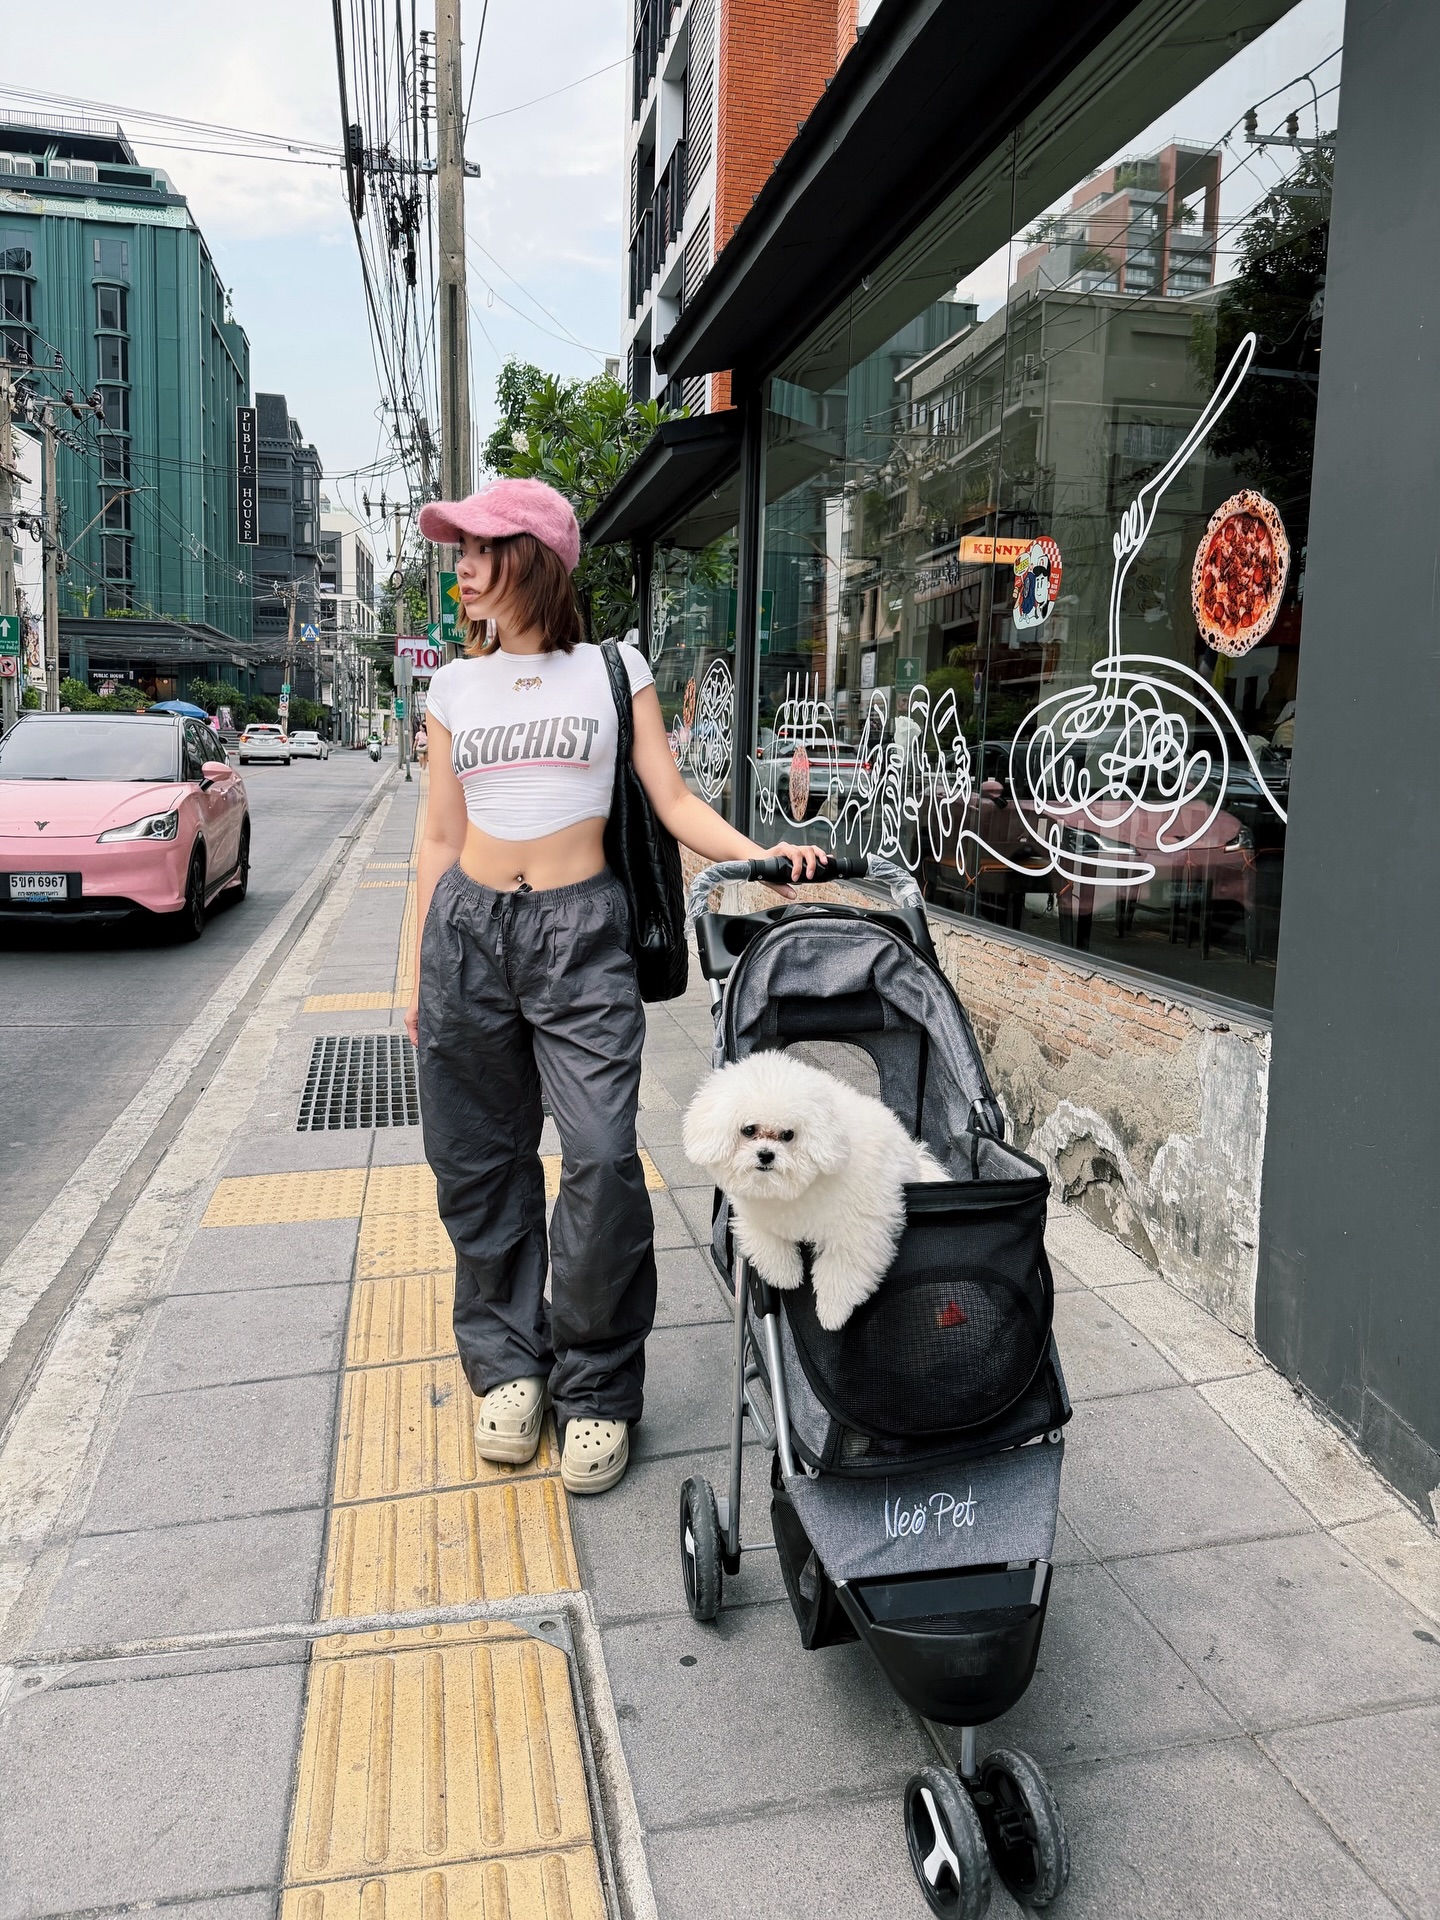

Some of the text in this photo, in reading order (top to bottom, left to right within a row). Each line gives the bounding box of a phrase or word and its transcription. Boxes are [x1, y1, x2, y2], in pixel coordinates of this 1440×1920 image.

[242, 411, 253, 540] PUBLIC HOUSE
[451, 716, 599, 776] ASOCHIST
[38, 876, 65, 888] 6967
[929, 1485, 978, 1536] Pet
